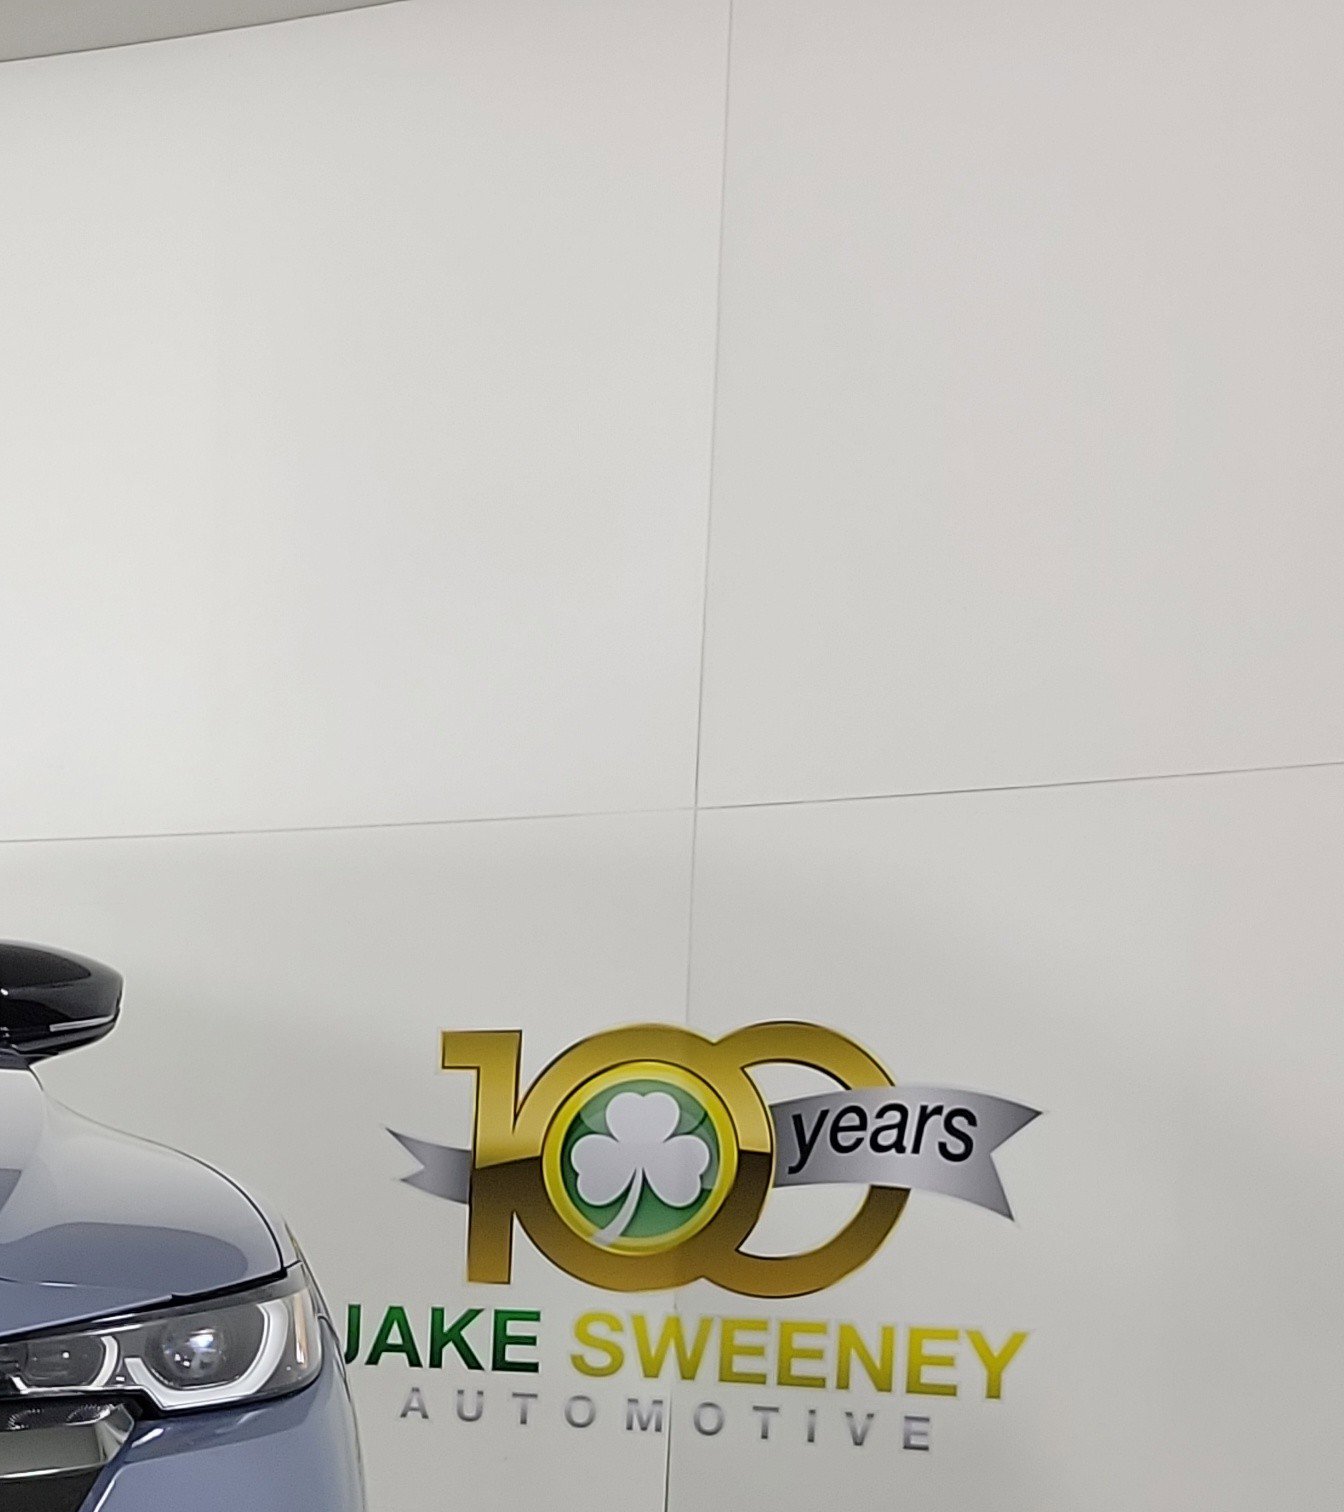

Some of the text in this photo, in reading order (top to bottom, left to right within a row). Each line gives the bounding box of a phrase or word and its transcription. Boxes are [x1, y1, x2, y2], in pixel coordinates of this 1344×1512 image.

[439, 1022, 912, 1299] 100
[787, 1103, 978, 1175] years
[569, 1312, 1031, 1401] SWEENEY
[399, 1386, 932, 1452] AUTOMOTIVE
